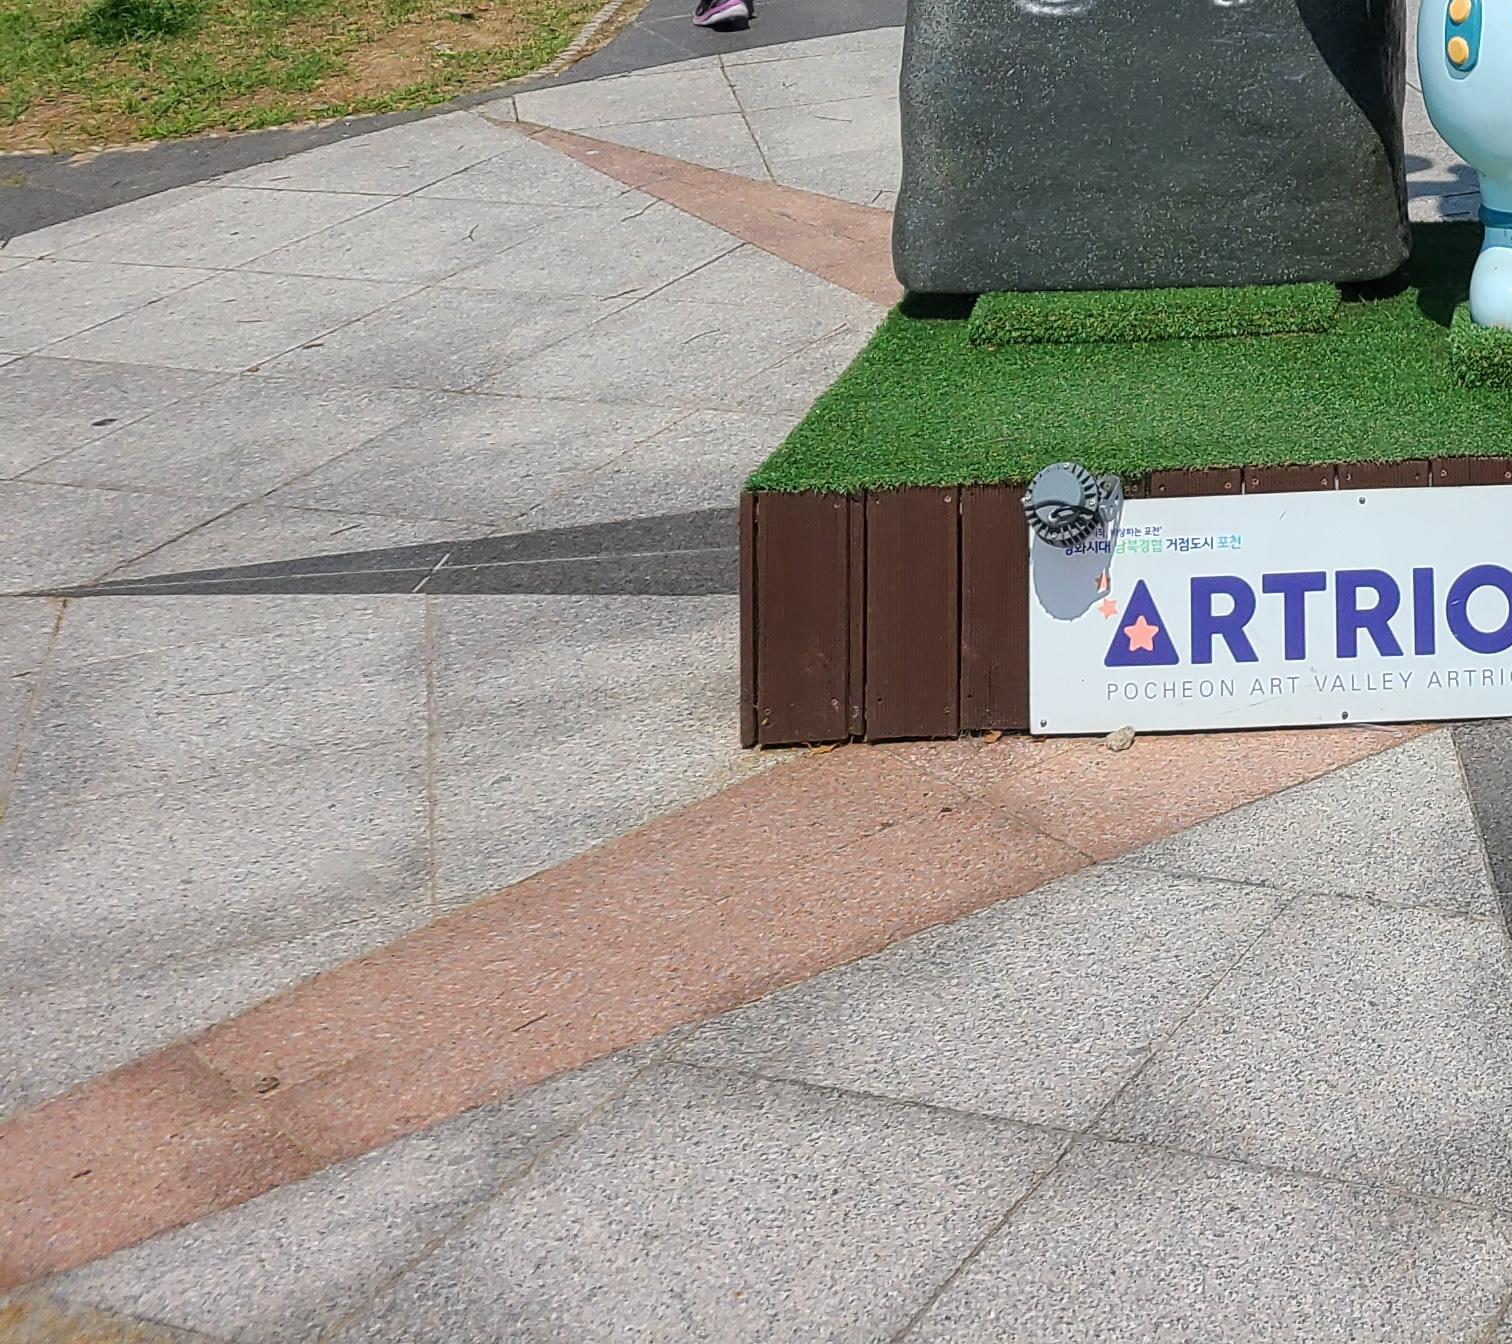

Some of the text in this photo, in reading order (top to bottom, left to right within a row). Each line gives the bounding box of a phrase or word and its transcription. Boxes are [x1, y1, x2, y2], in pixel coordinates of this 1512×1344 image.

[1166, 536, 1214, 553] 거점도시
[1217, 534, 1242, 550] 포천
[1106, 680, 1236, 701] POCHEON
[1249, 676, 1301, 697] ART
[1314, 671, 1414, 693] VALLEY
